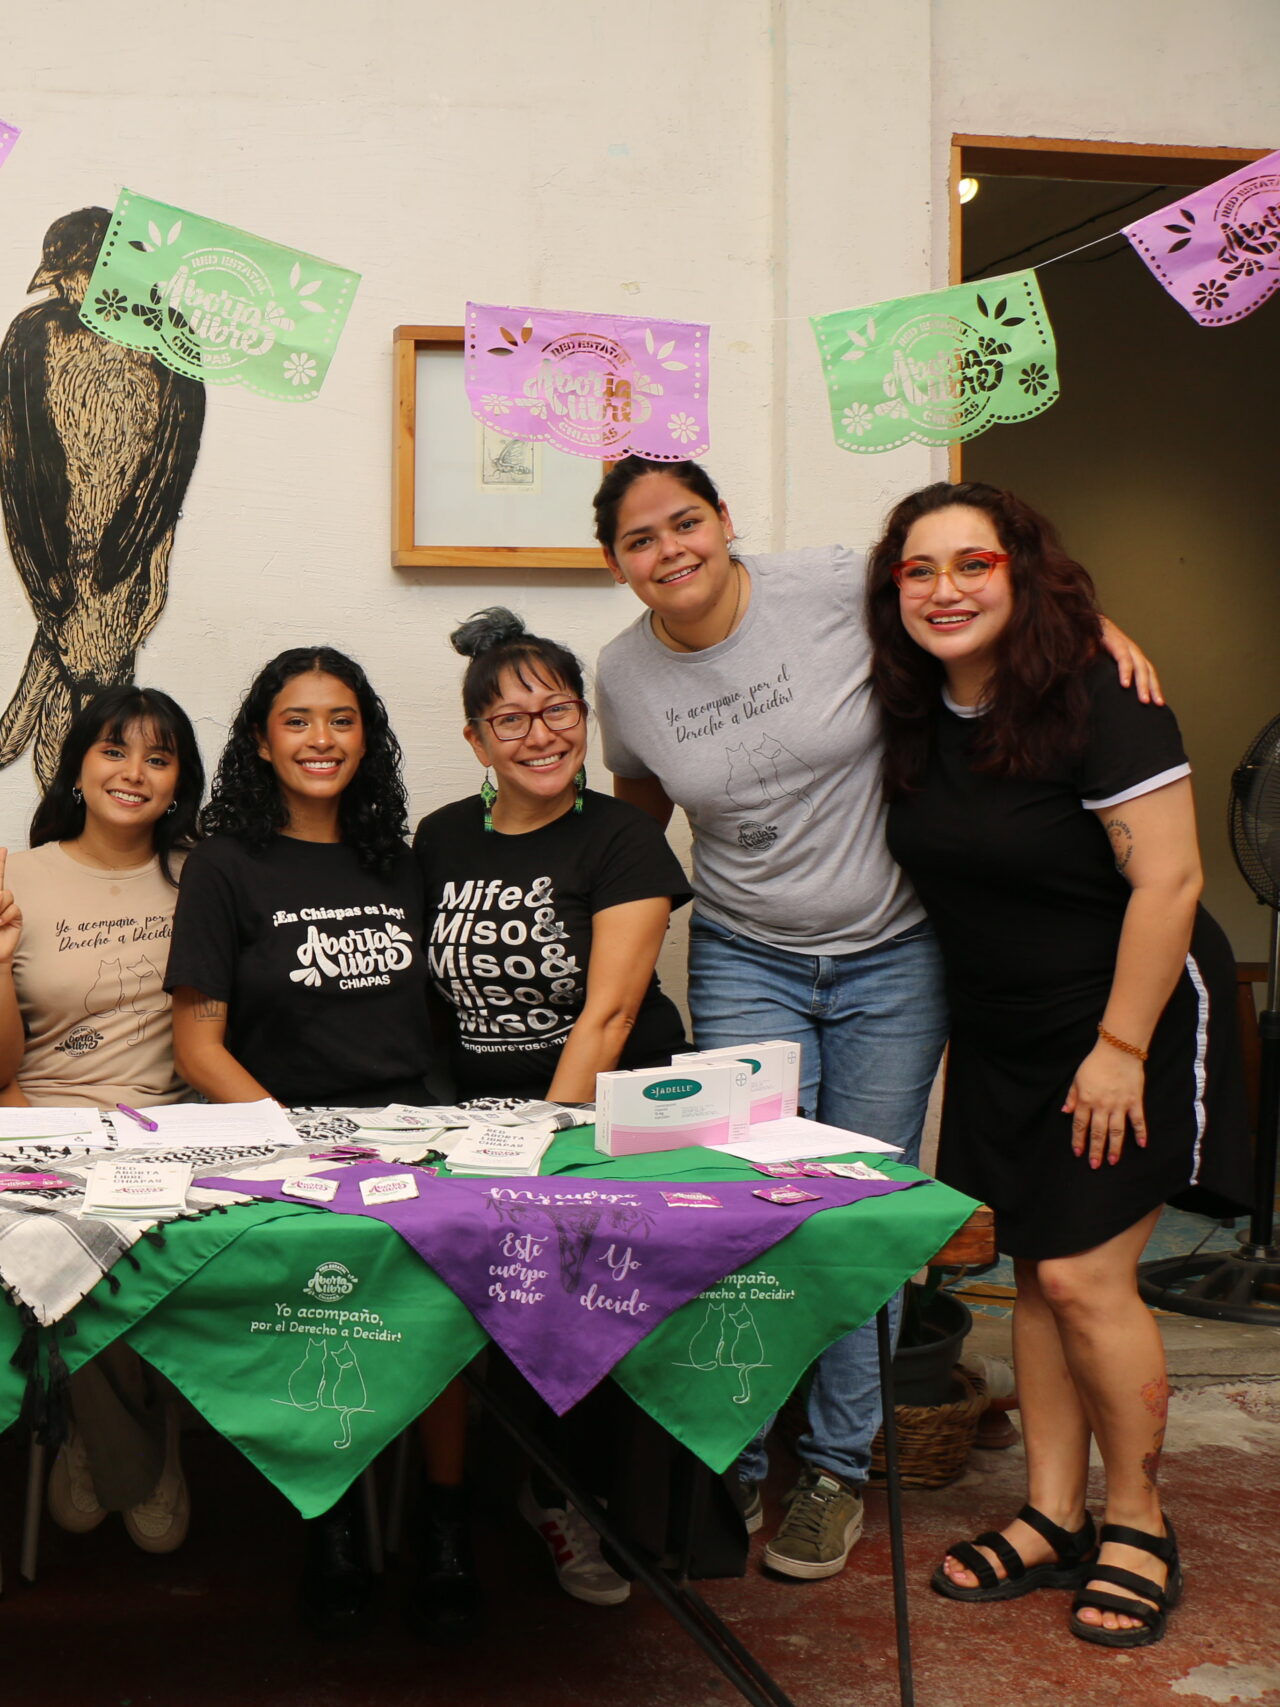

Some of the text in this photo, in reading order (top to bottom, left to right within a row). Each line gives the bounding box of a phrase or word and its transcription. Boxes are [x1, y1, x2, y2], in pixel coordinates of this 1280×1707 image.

[1237, 178, 1280, 198] ESTAT
[172, 335, 231, 364] CHIAPAS
[577, 341, 628, 367] ESTATAL
[558, 421, 618, 443] CHIAPAS
[666, 708, 680, 727] Yo
[749, 680, 771, 700] por
[777, 663, 791, 683] el
[676, 688, 793, 744] Derecho a Decidir!
[437, 876, 555, 911] Mife&
[56, 919, 72, 937] Yo
[145, 915, 168, 929] por
[273, 903, 406, 927] ¡En Chiapas es Ley!
[430, 906, 571, 946] Miso&
[59, 924, 173, 952] Derecho a Decidi
[297, 925, 392, 977] Aborta
[337, 941, 413, 977] libre
[428, 943, 582, 980] Miso&
[339, 974, 391, 990] CHIAPAS
[655, 1085, 691, 1097] JADELLE
[499, 1233, 549, 1263] Este
[596, 1244, 642, 1281] Yo
[308, 1271, 347, 1293] Aborta
[489, 1263, 548, 1288] cuerpo
[715, 1271, 780, 1289] mpaño,
[489, 1283, 507, 1302] es
[580, 1283, 651, 1315] decido
[750, 1288, 796, 1300] Decidir!
[275, 1302, 384, 1327] Yo acompaño,
[250, 1321, 402, 1343] por el Derecho a Decidir!
